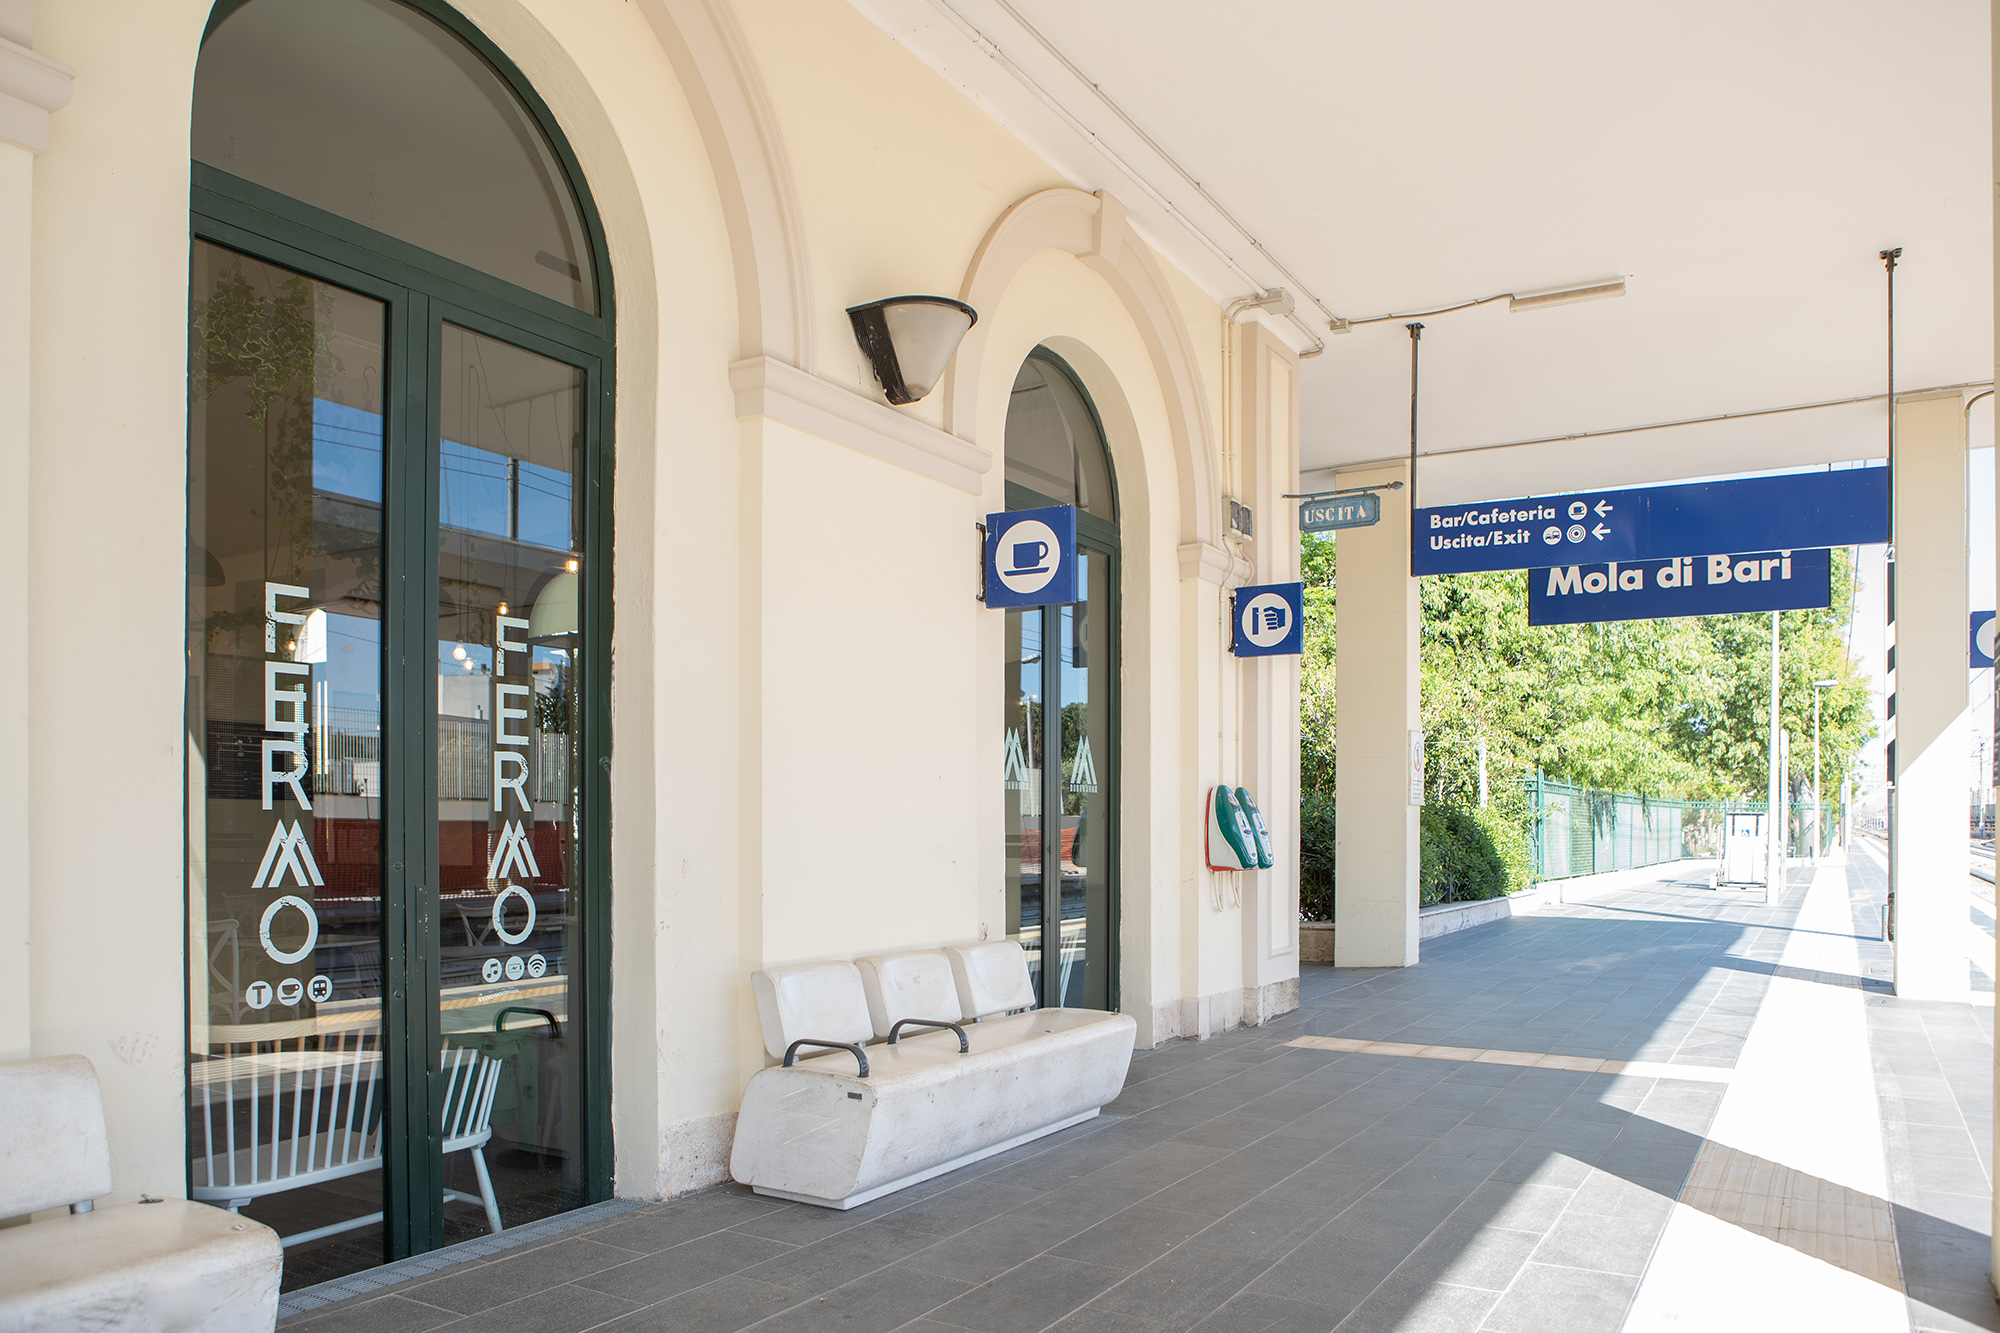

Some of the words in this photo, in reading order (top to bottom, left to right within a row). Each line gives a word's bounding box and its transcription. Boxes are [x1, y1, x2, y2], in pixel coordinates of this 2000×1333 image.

[1304, 504, 1367, 524] USCITA
[1430, 505, 1556, 529] Bar/Cafeteria
[1430, 528, 1531, 551] Uscita/Exit
[1546, 561, 1644, 597] Mola
[1656, 556, 1693, 589] di
[1707, 550, 1792, 585] Bari
[251, 581, 325, 965] FERMO
[487, 615, 541, 945] FERMO
